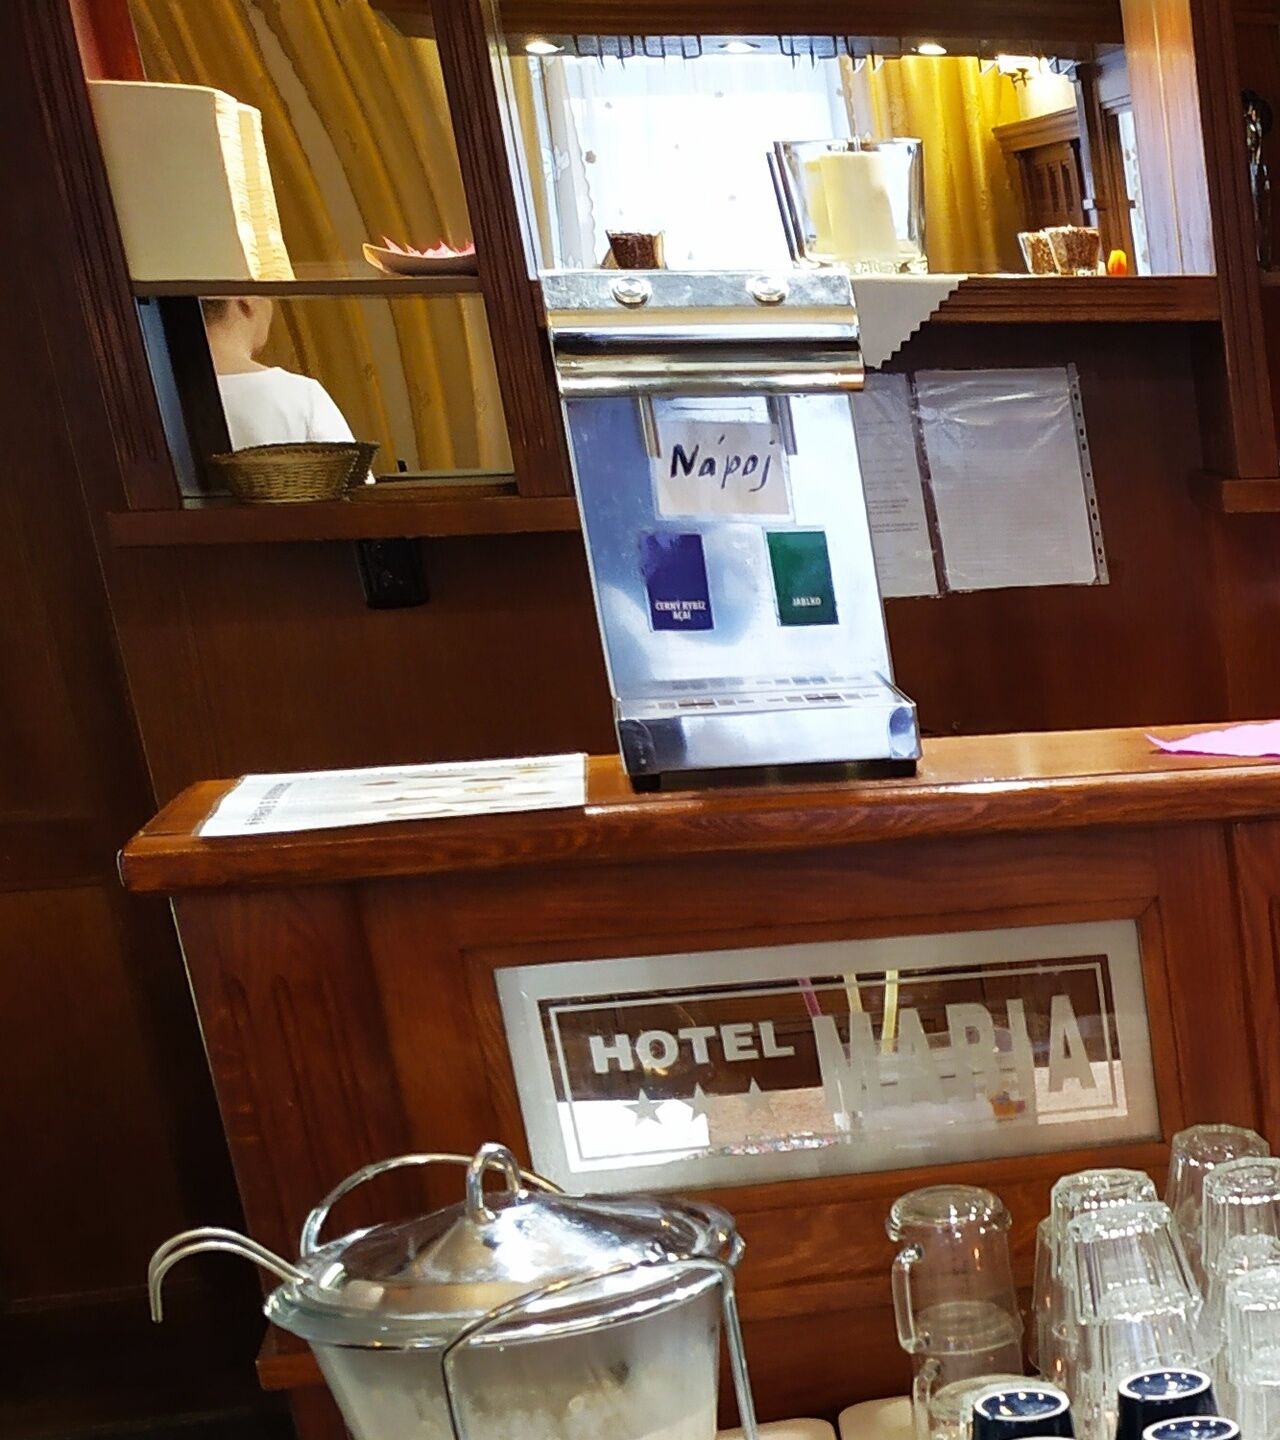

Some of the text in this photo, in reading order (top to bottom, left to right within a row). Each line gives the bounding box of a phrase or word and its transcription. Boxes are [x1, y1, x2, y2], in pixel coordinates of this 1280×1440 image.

[670, 434, 776, 492] Nápoj
[588, 994, 1099, 1115] HOTEL MARIA
